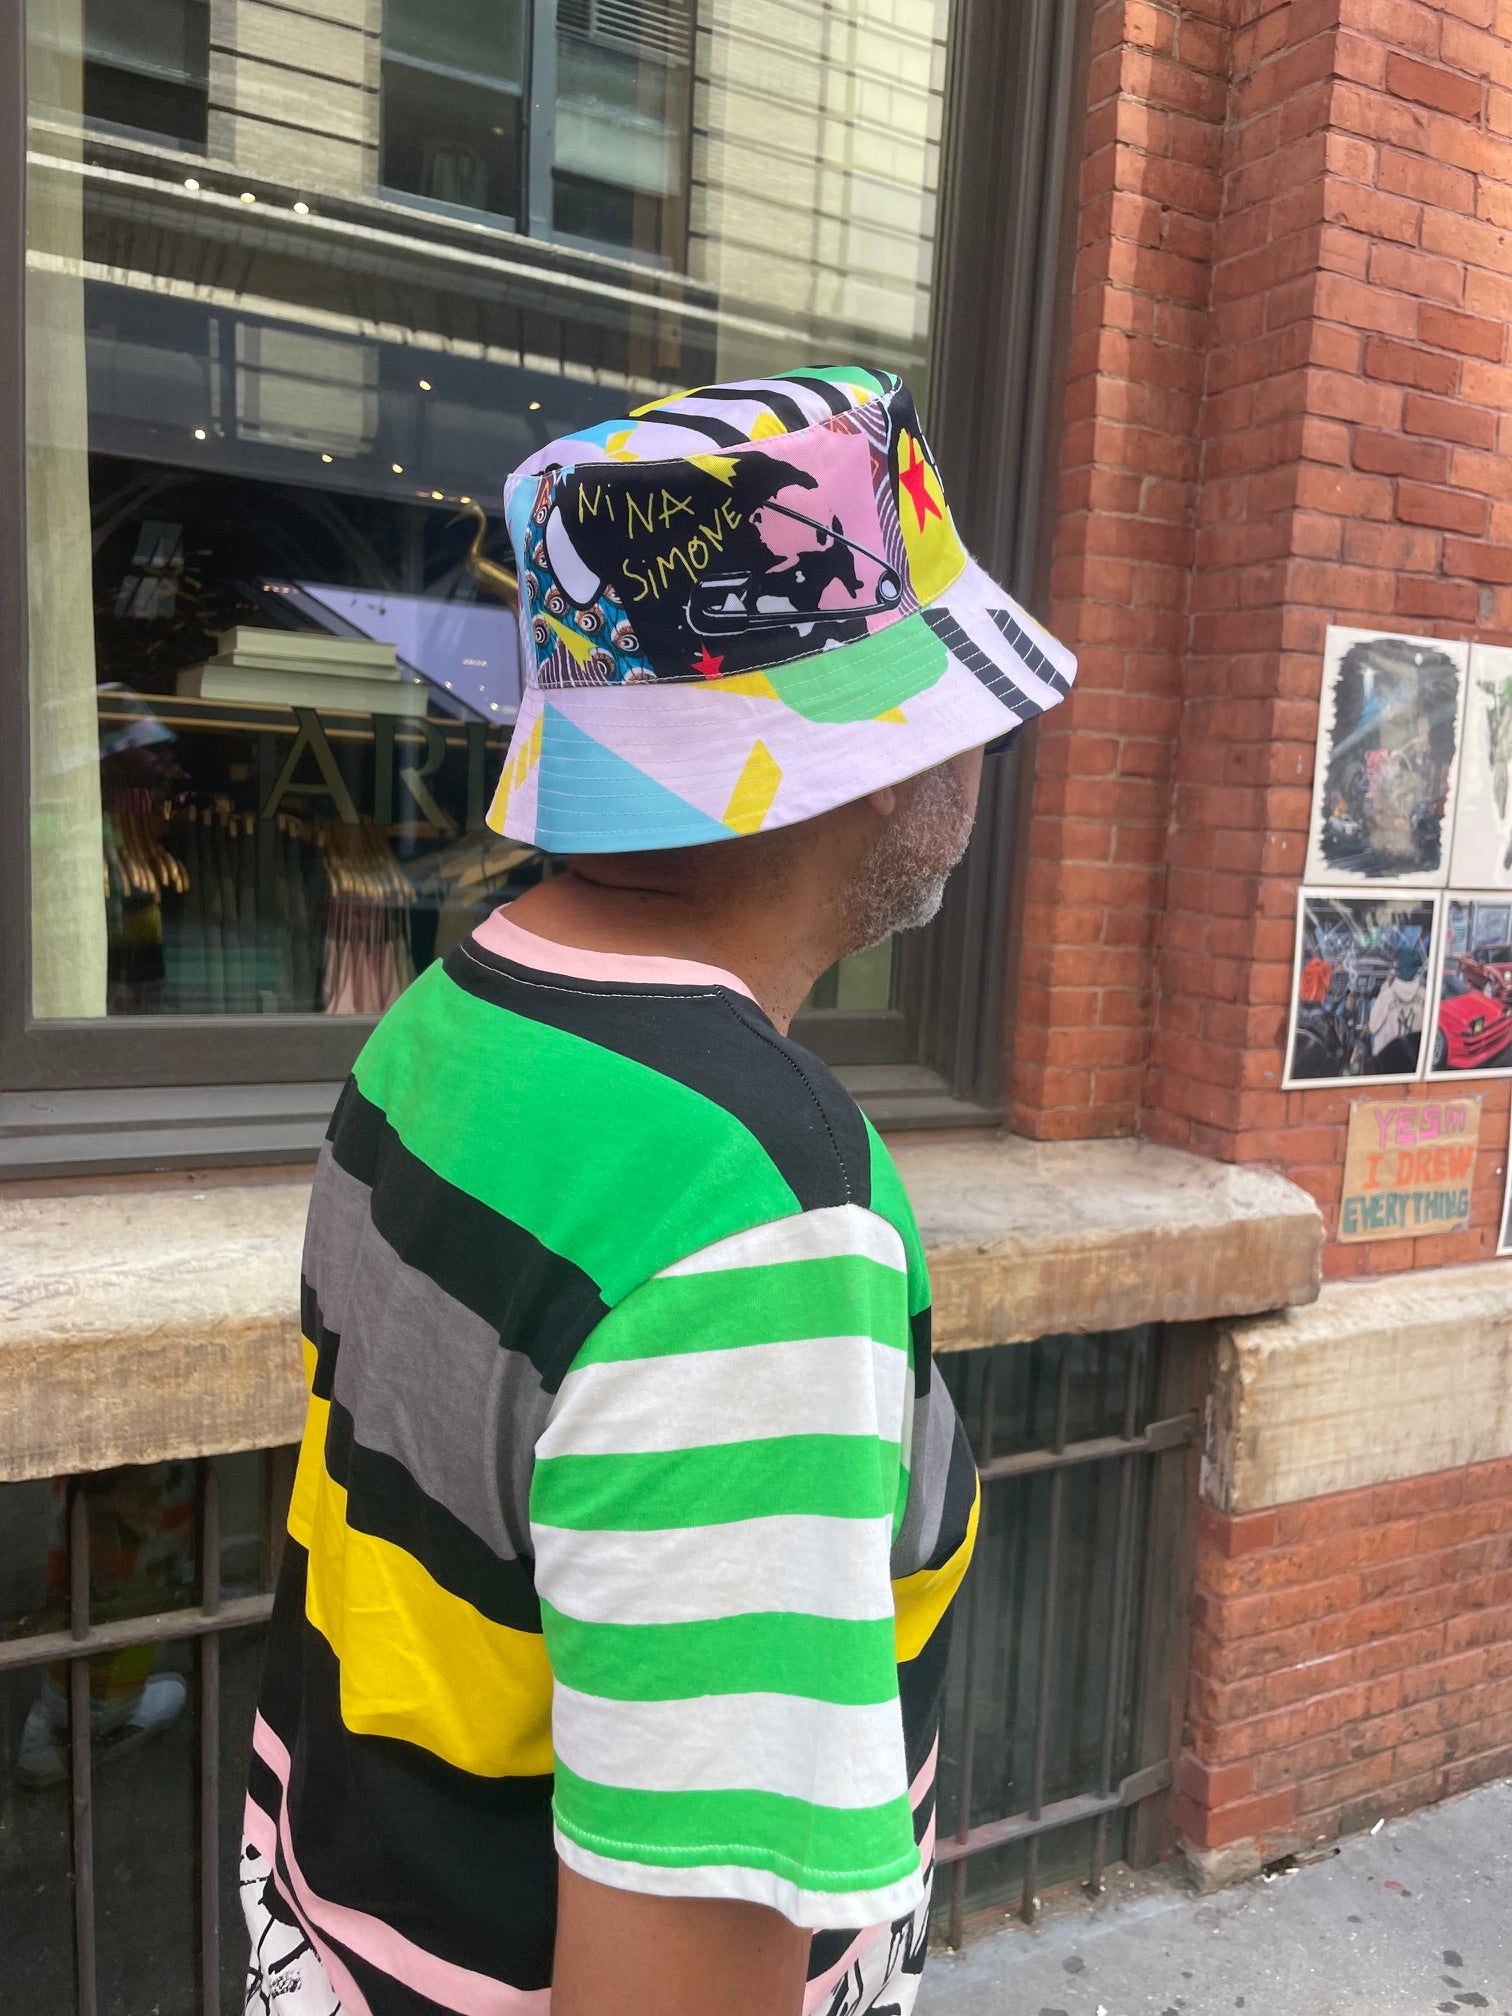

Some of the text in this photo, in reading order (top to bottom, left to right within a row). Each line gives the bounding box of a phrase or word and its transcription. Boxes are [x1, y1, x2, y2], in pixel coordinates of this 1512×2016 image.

[1362, 1146, 1475, 1190] I DREW
[1342, 1189, 1469, 1233] EVERYTHING
